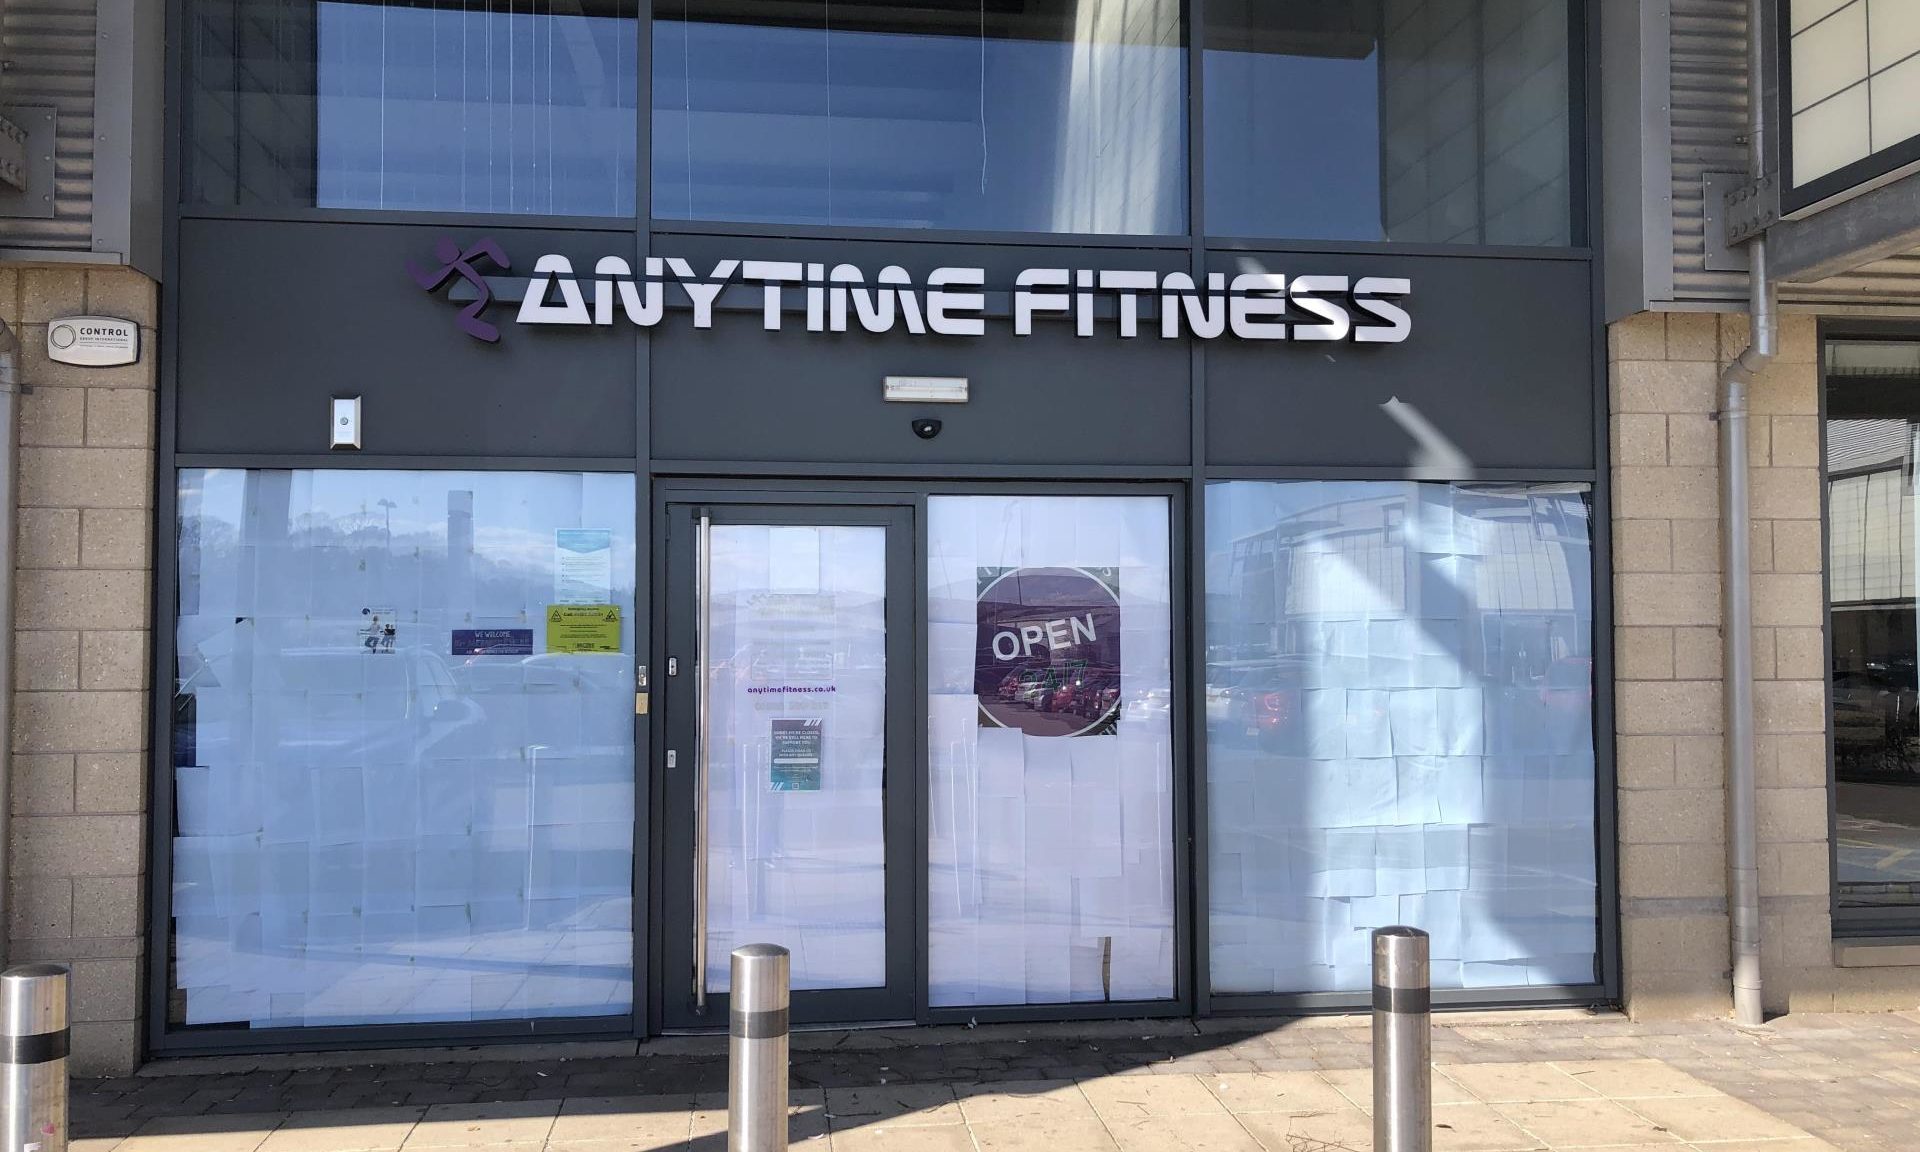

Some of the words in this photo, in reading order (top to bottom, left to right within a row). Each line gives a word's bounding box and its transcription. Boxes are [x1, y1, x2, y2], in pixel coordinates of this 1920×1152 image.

[515, 253, 985, 336] ANYTIME
[1014, 267, 1412, 343] FITNESS
[80, 328, 128, 336] CONTROL
[991, 612, 1098, 662] OPEN
[747, 685, 837, 695] anytimefitness.co.uk
[1018, 658, 1089, 693] 24/7
